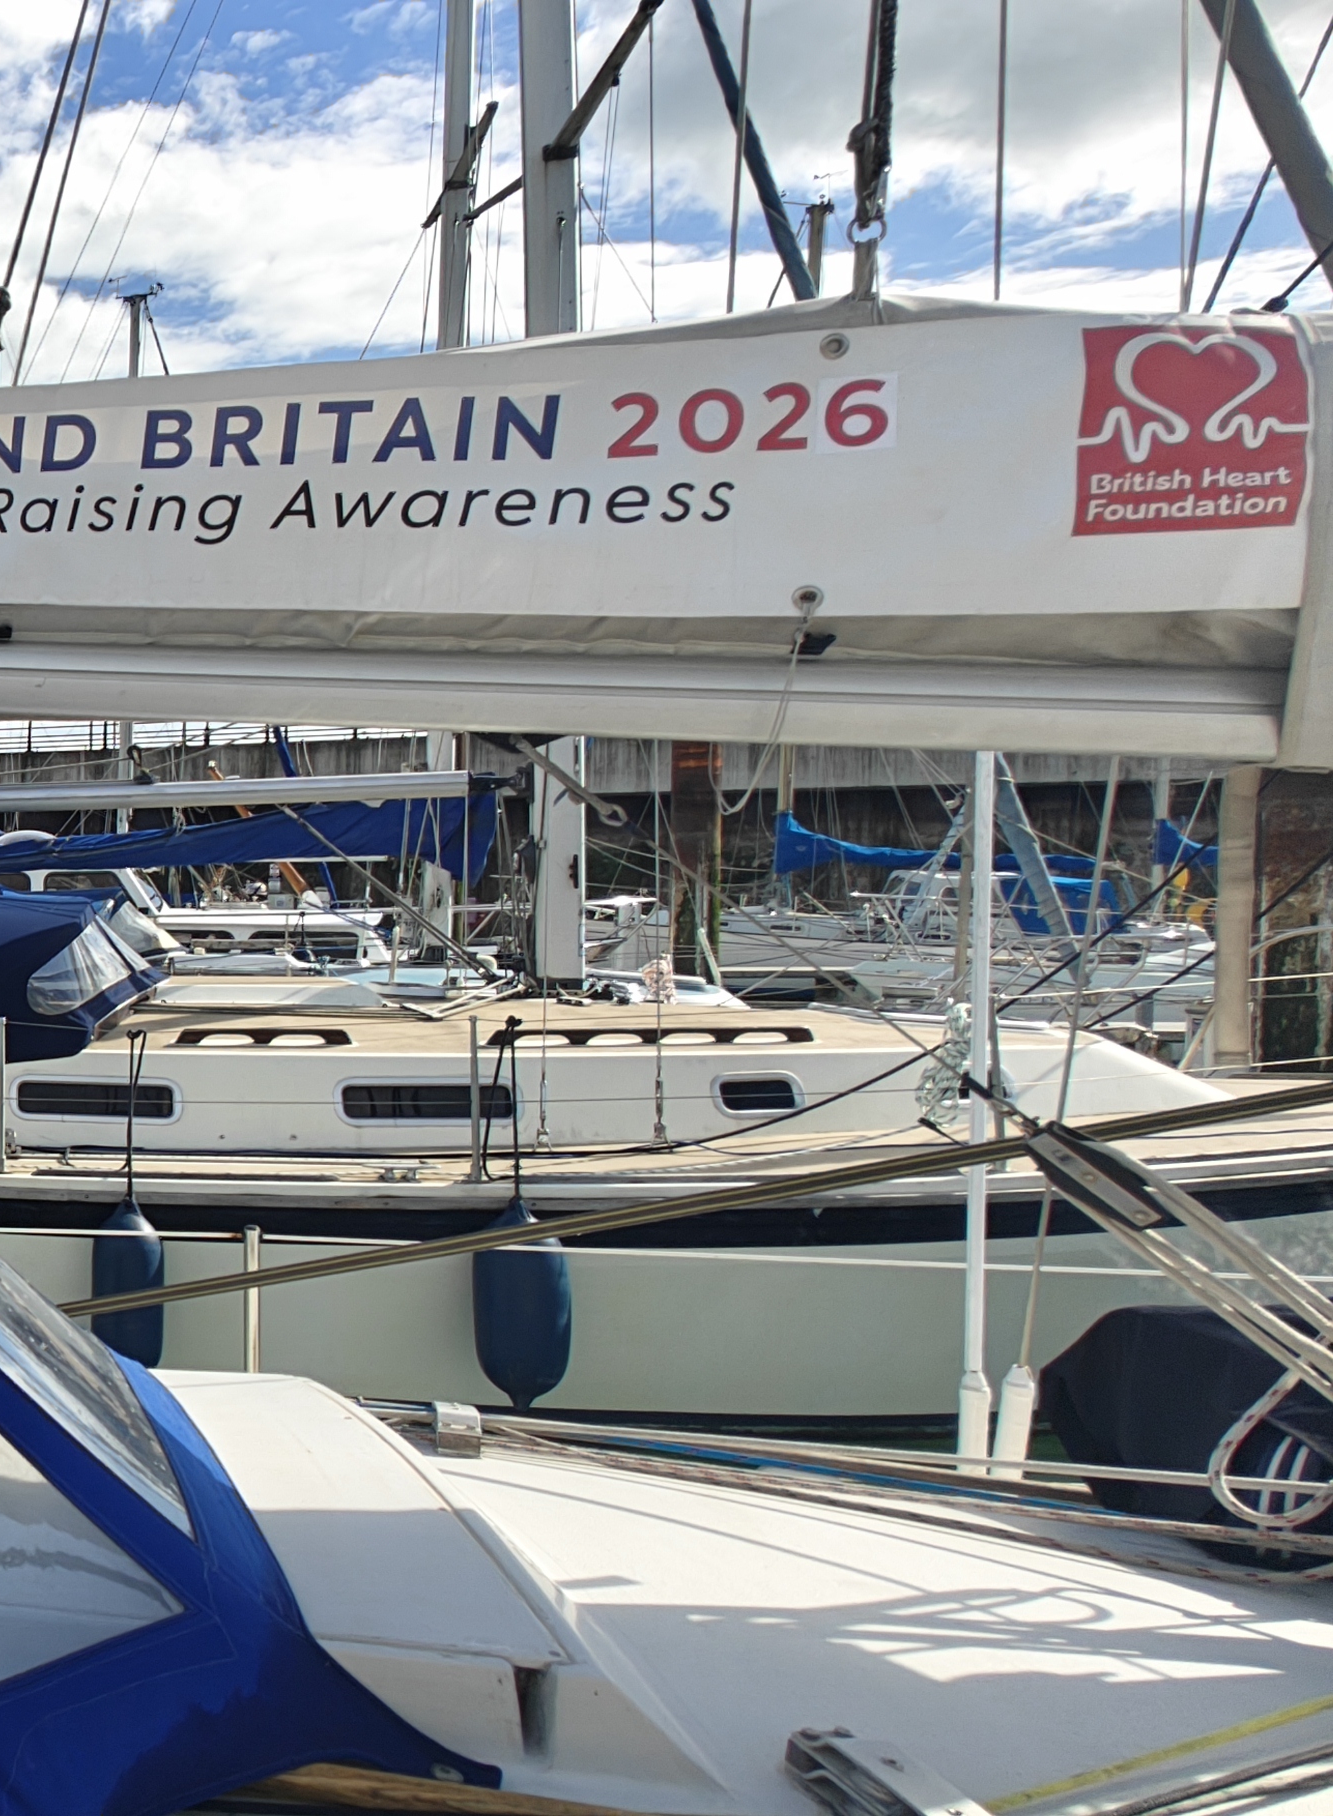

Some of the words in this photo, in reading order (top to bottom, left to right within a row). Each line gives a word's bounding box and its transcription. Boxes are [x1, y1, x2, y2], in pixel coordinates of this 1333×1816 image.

[139, 393, 562, 470] BRITAIN
[606, 378, 889, 459] 2026
[1090, 469, 1191, 494] British
[1202, 466, 1292, 488] Heart
[269, 479, 735, 531] Awareness
[1086, 493, 1288, 522] Foundation
